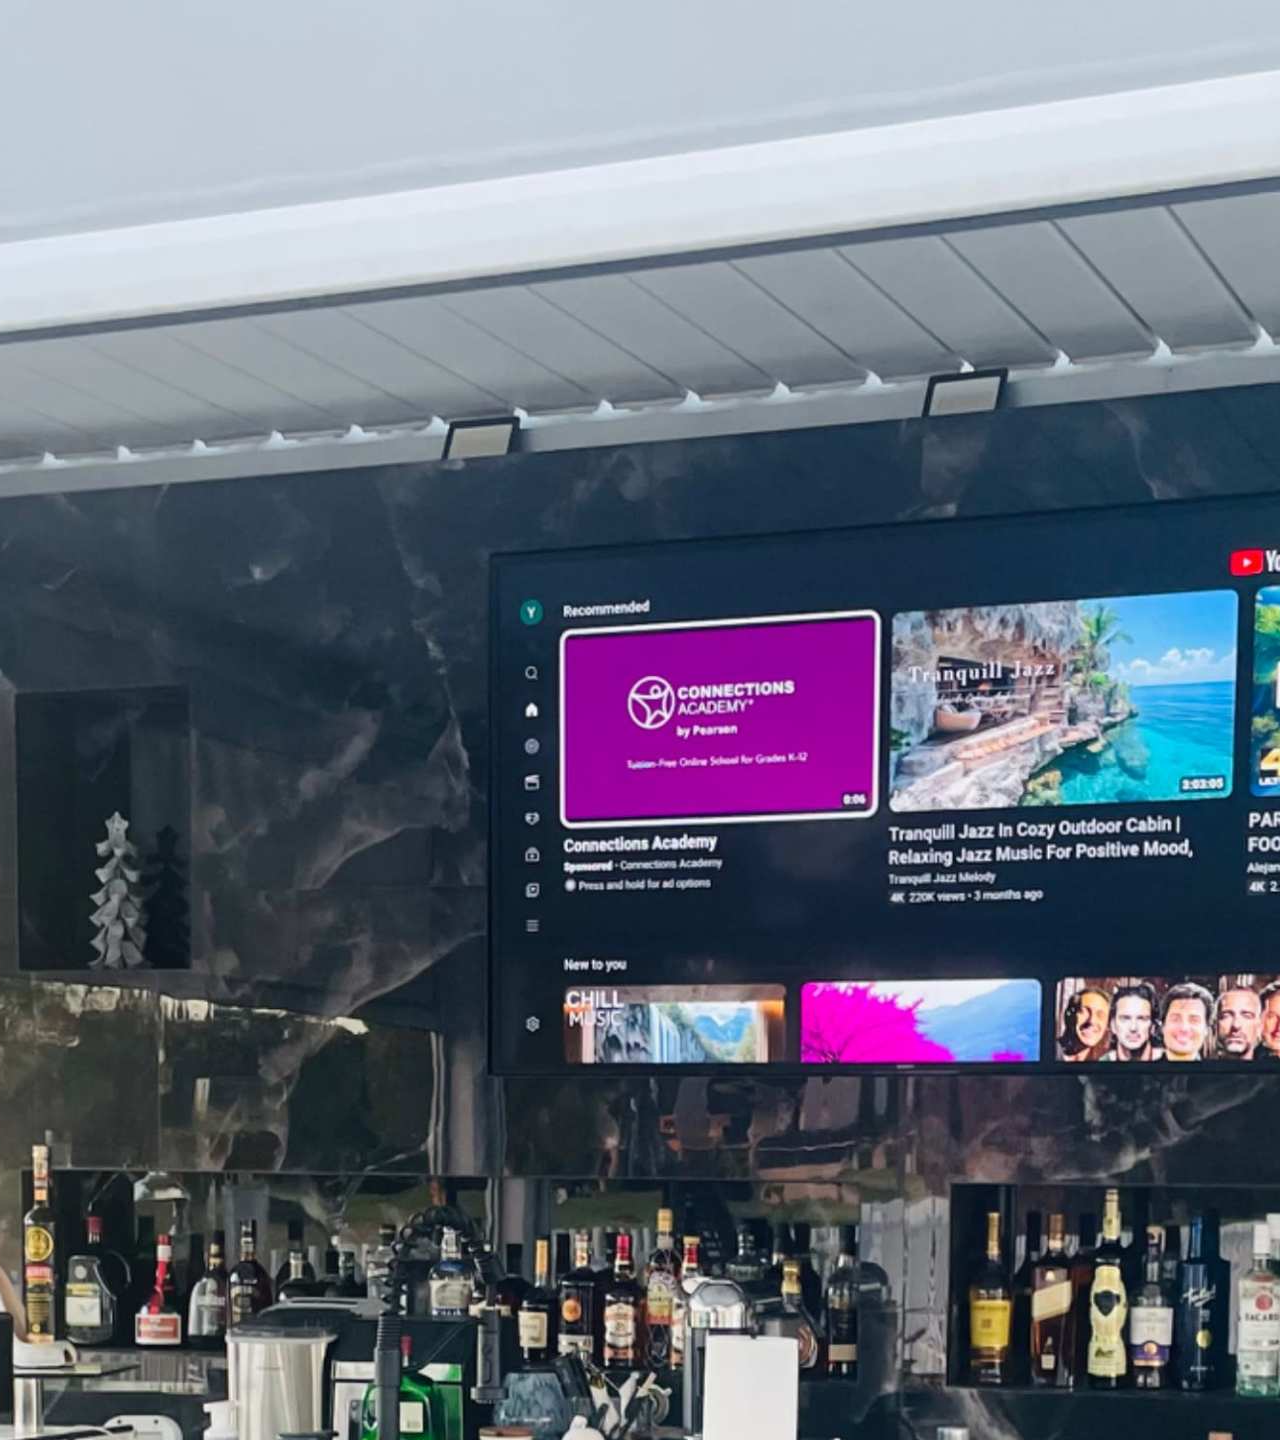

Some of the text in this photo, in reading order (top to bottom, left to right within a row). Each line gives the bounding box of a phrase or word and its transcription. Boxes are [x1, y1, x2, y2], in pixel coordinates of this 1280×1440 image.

[563, 601, 650, 618] Recommended
[908, 660, 1055, 686] Tranquill Jazz
[677, 681, 795, 700] CONNECTIONS
[676, 724, 738, 738] by Pearson
[679, 756, 707, 767] Online
[710, 755, 739, 766] School
[740, 754, 753, 764] for
[755, 752, 786, 764] Grades
[888, 825, 955, 844] Tranquill
[959, 823, 995, 839] Jazz
[999, 823, 1013, 837] In
[1017, 822, 1055, 839] Cozy
[1058, 818, 1122, 835] Outdoor
[1126, 816, 1172, 834] Cabin
[563, 833, 718, 853] Connections Academy
[888, 839, 1193, 866] Relaxing Jazz Music For Positive Mood,
[563, 858, 723, 873] Sponsored Connections Academy
[578, 879, 711, 891] Press and hold for ad options
[888, 872, 997, 885] Tranquill Jazz Melody
[1249, 881, 1266, 893] 4K
[890, 892, 905, 903] 4K
[937, 892, 965, 902] views
[982, 890, 1021, 901] months
[1023, 889, 1044, 902] ago
[564, 958, 627, 972] New to you
[566, 990, 624, 1009] CHILL
[569, 1009, 622, 1027] MUSIC
